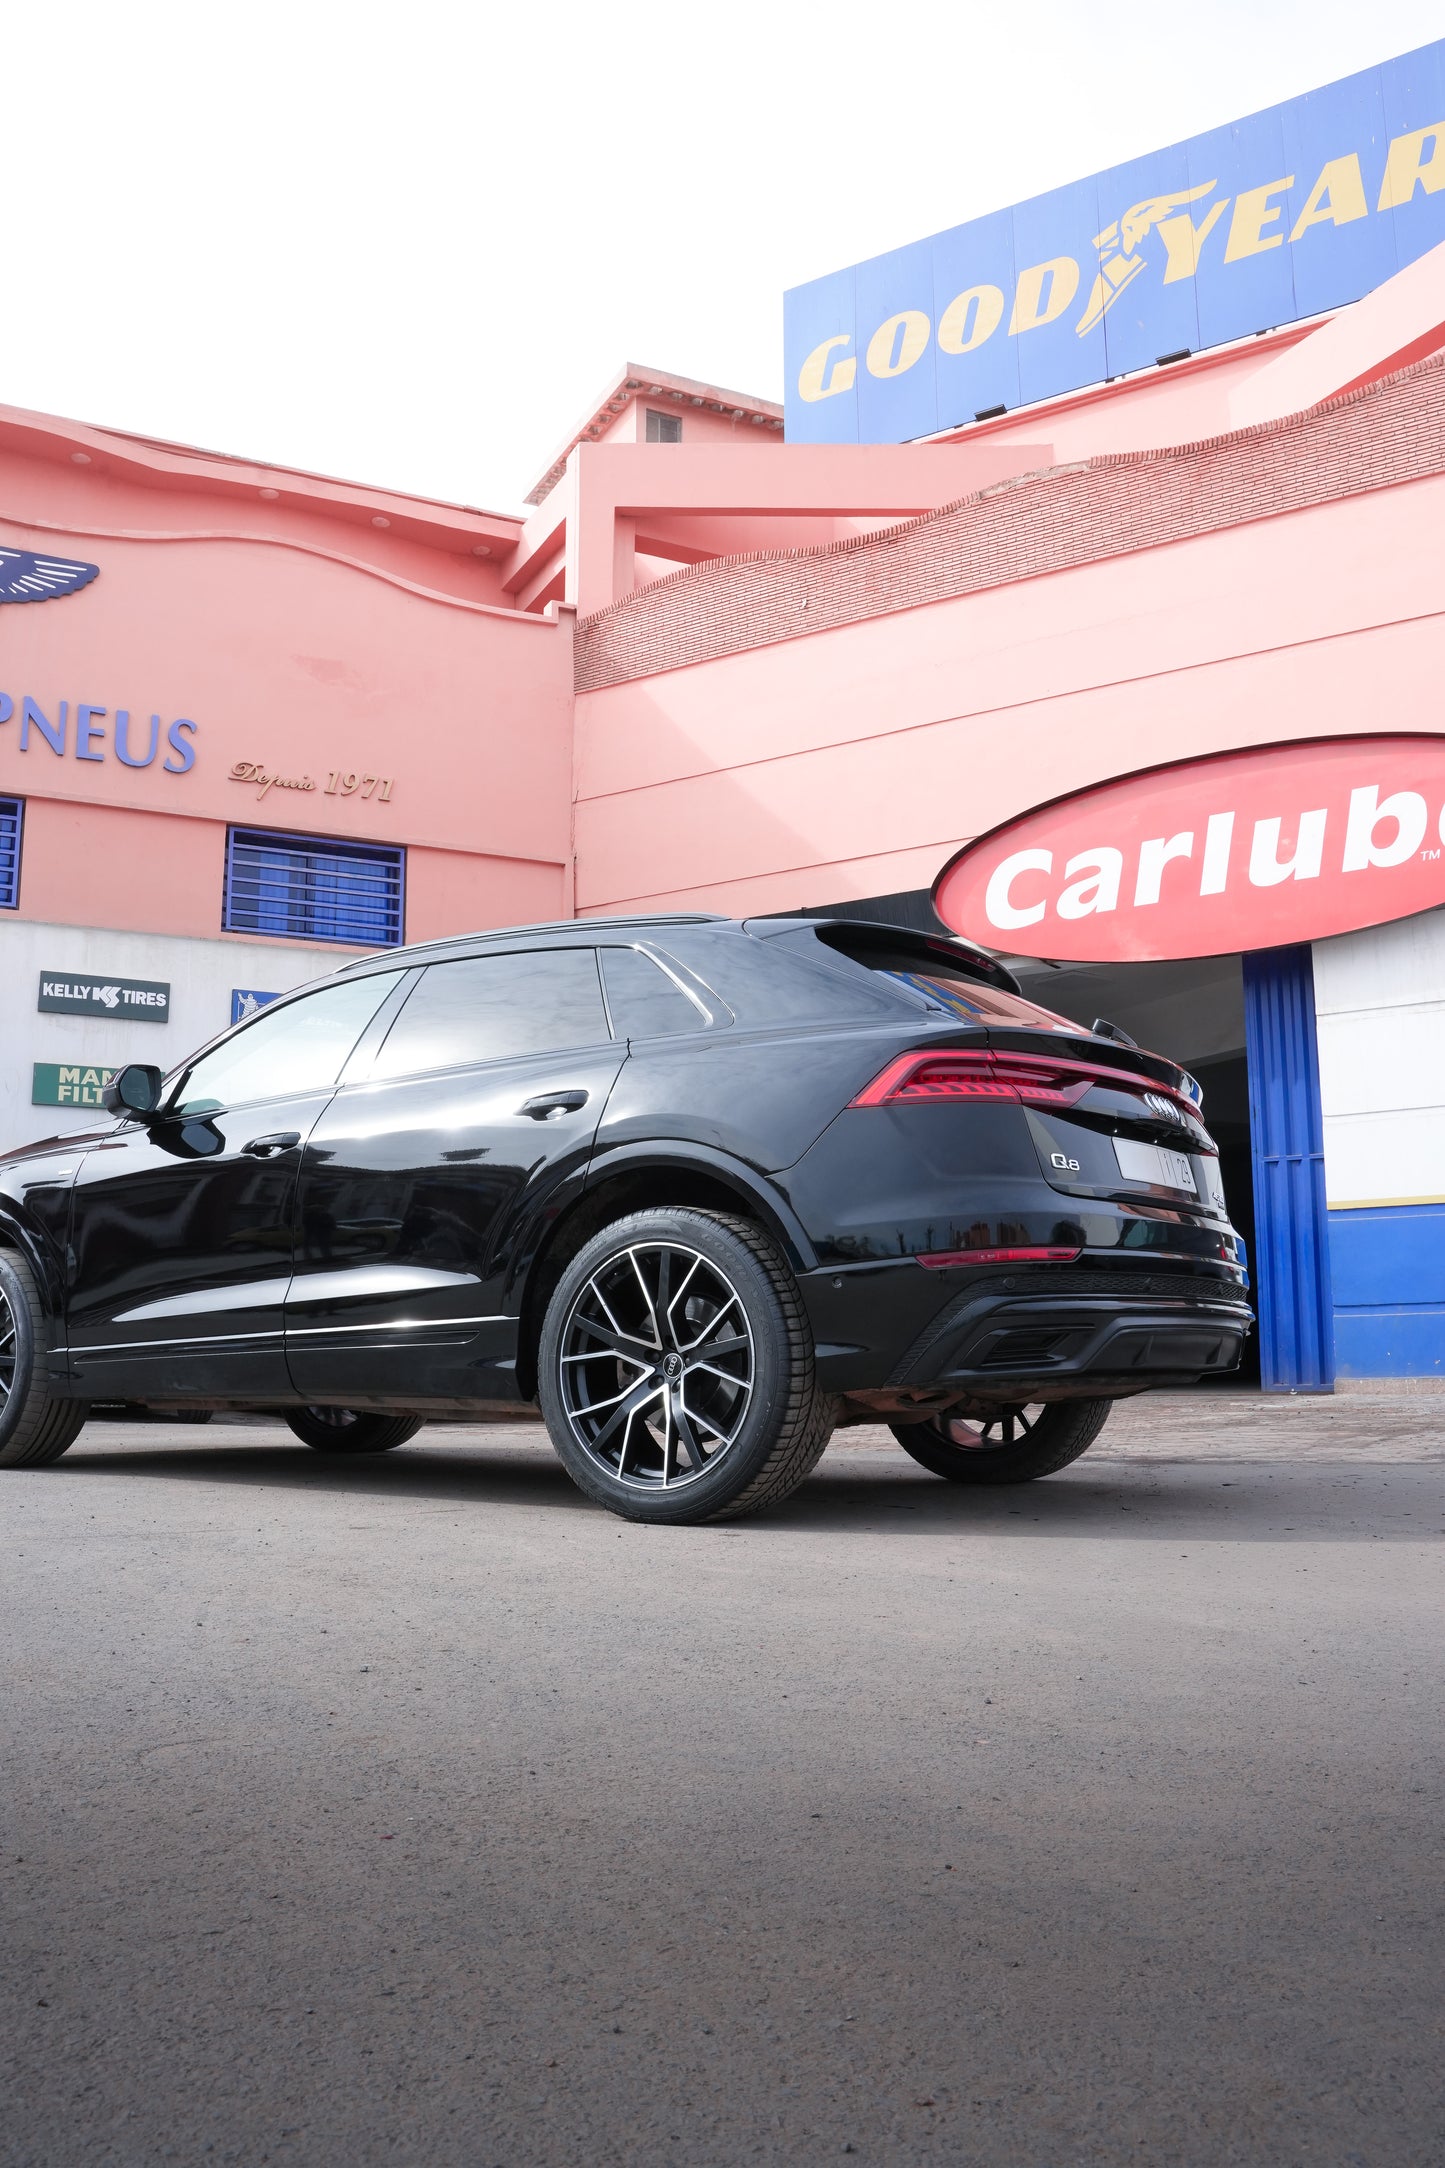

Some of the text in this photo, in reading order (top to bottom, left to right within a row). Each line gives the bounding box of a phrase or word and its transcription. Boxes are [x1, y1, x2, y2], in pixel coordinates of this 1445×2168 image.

[228, 761, 394, 802] Depuis 1971
[985, 784, 1445, 931] Carlub
[42, 982, 91, 1000] KELLY
[122, 989, 167, 1007] TIRES
[1050, 1153, 1080, 1171] Q8
